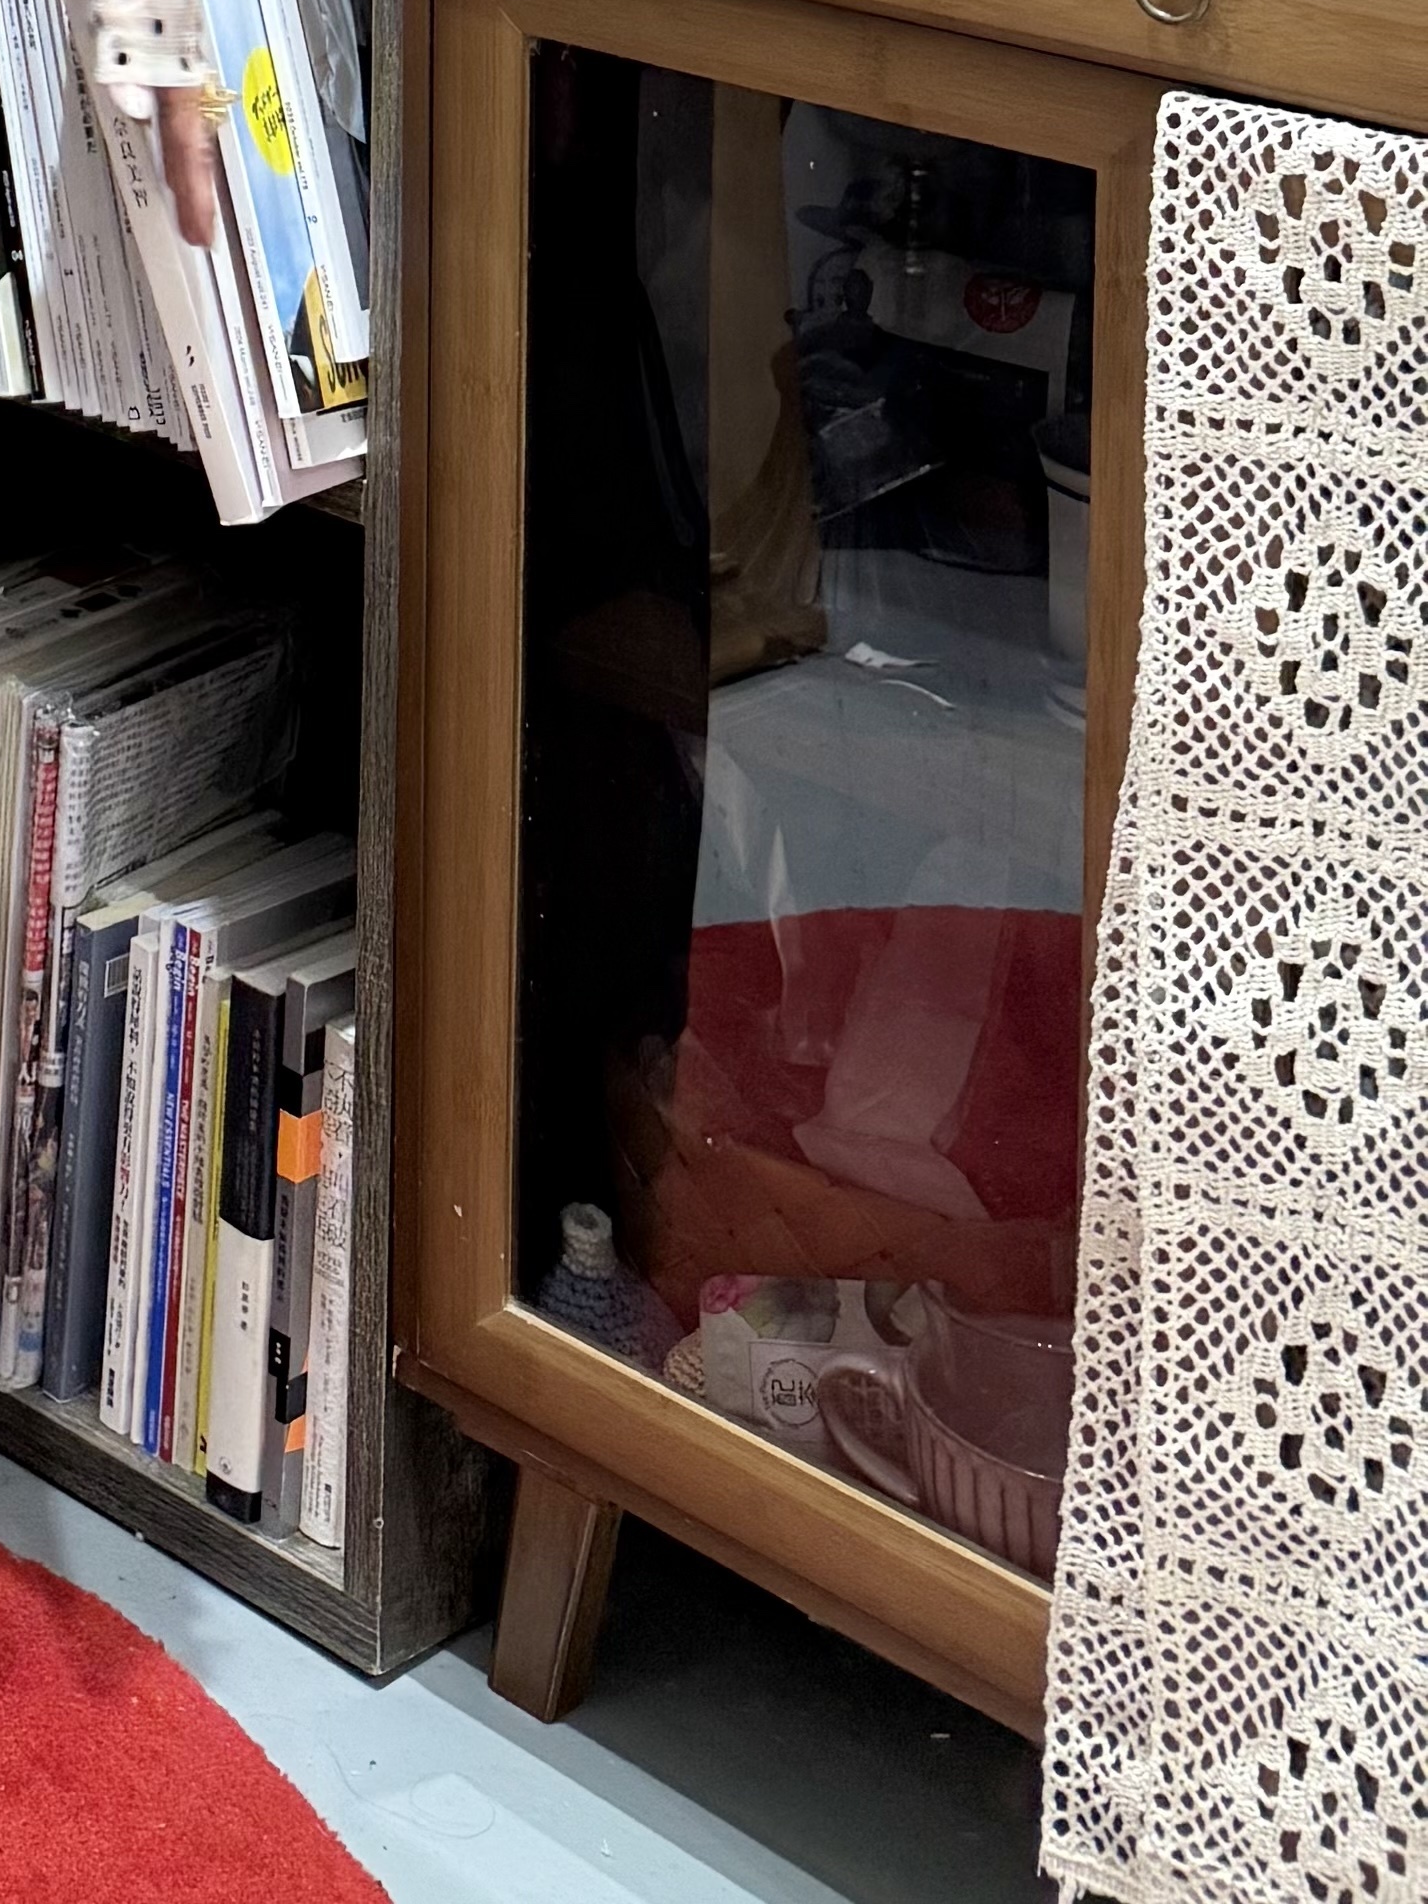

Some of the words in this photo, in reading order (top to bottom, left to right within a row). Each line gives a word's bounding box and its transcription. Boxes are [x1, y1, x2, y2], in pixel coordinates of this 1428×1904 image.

[172, 948, 187, 992] Begin
[189, 954, 200, 996] Begin
[160, 1118, 175, 1188] ESSENTIALS
